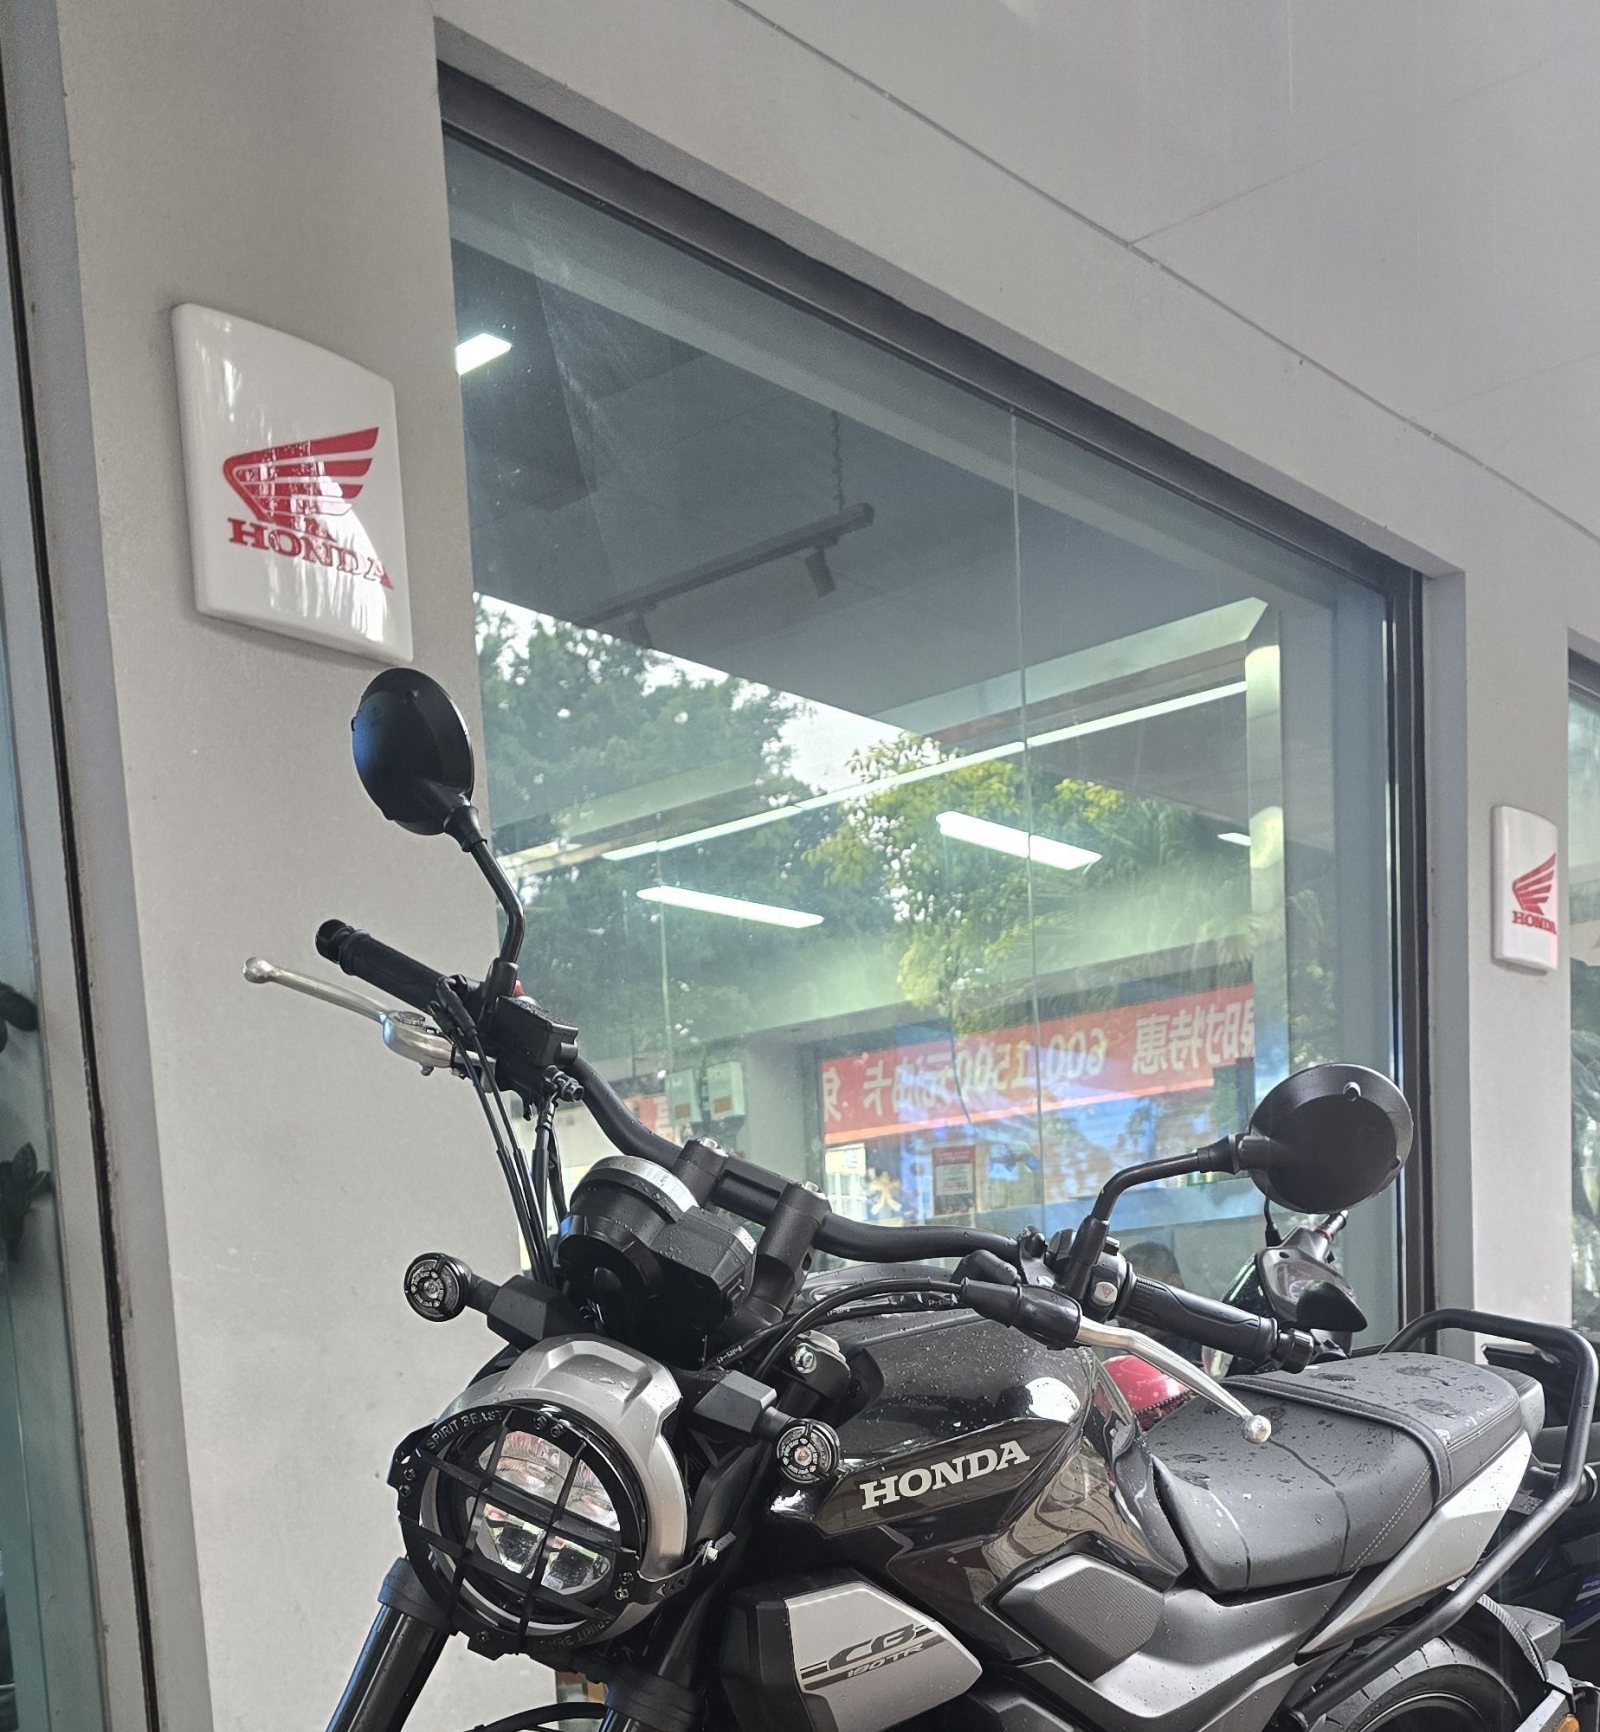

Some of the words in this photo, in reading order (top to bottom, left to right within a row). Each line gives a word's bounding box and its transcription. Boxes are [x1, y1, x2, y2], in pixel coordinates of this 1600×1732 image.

[227, 517, 395, 590] HONDA
[1512, 911, 1556, 934] HONDA
[426, 1419, 459, 1450] SPIRIT
[859, 1440, 1030, 1510] HONDA
[828, 1623, 915, 1670] CB
